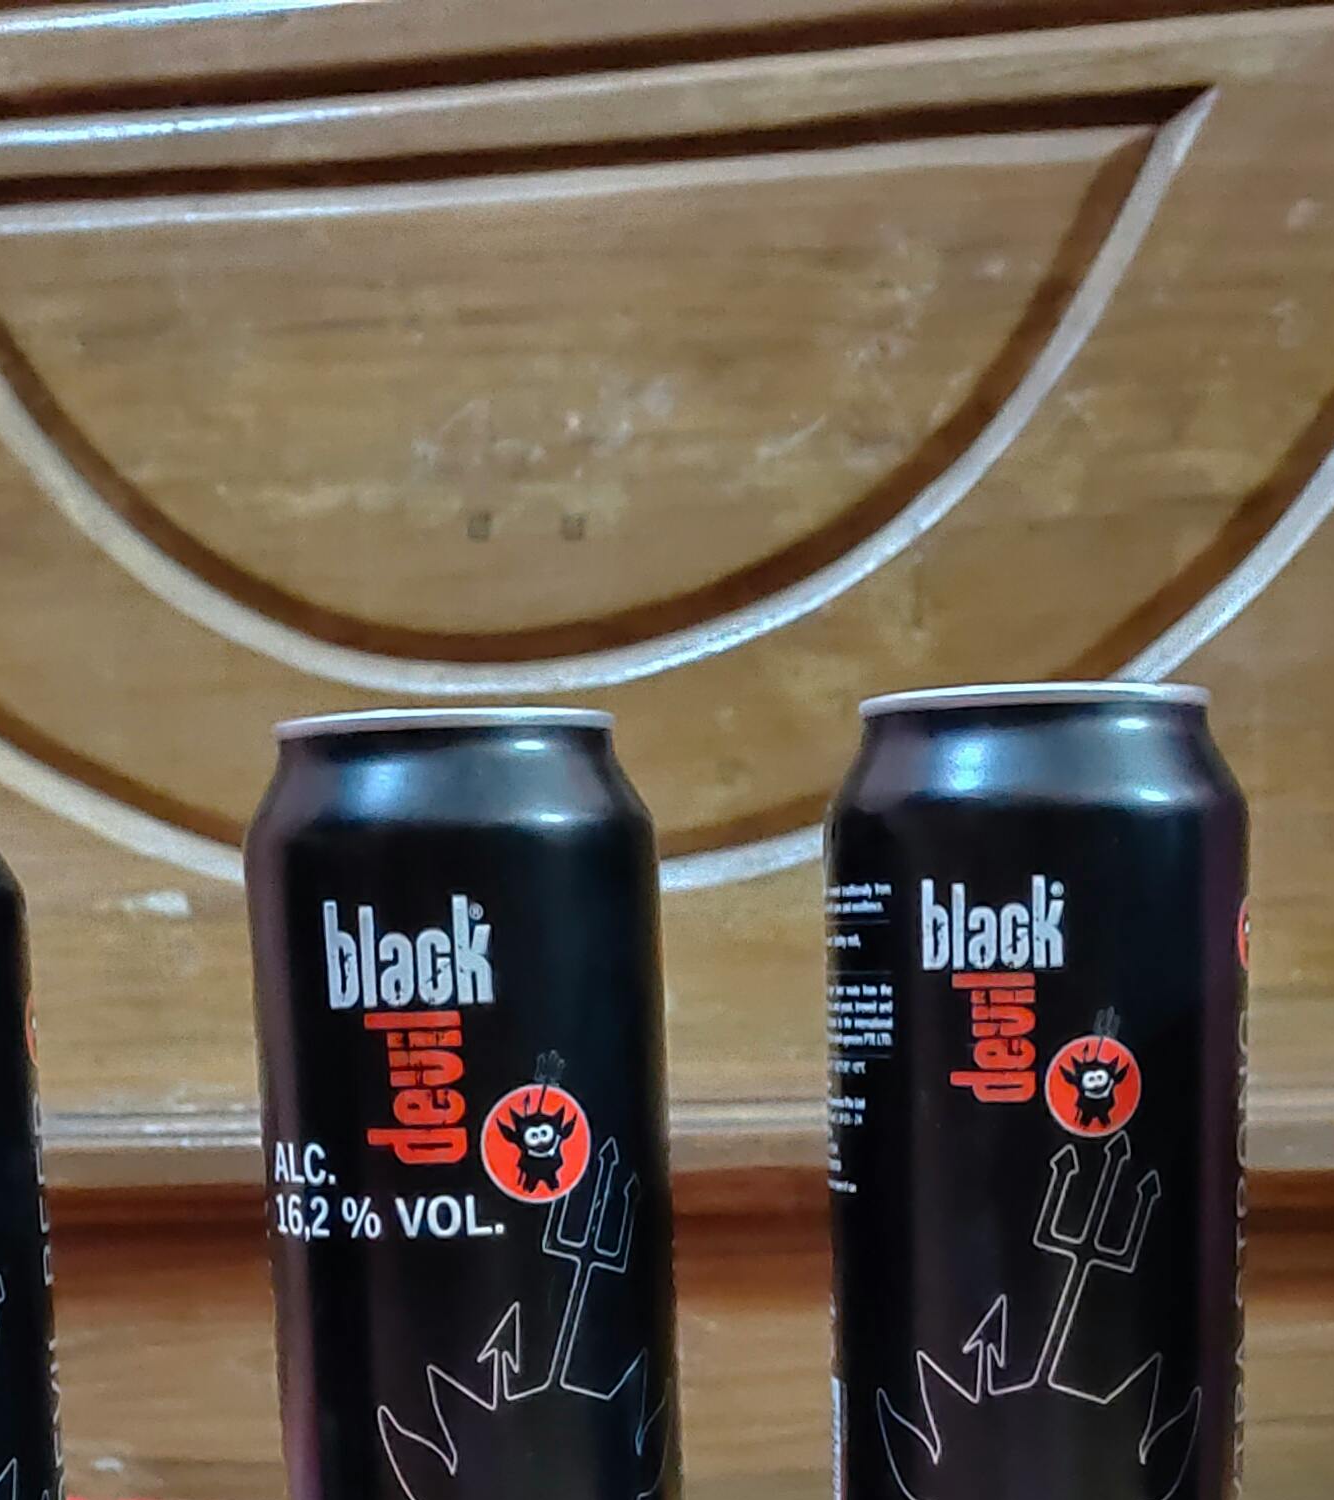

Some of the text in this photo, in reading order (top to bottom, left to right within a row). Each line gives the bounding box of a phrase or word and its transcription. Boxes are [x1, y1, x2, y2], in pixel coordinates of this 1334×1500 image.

[951, 971, 1036, 1102] devil
[364, 1011, 468, 1164] devil
[274, 1140, 336, 1187] ALC.
[275, 1192, 506, 1242] 16,2 % VOL.
